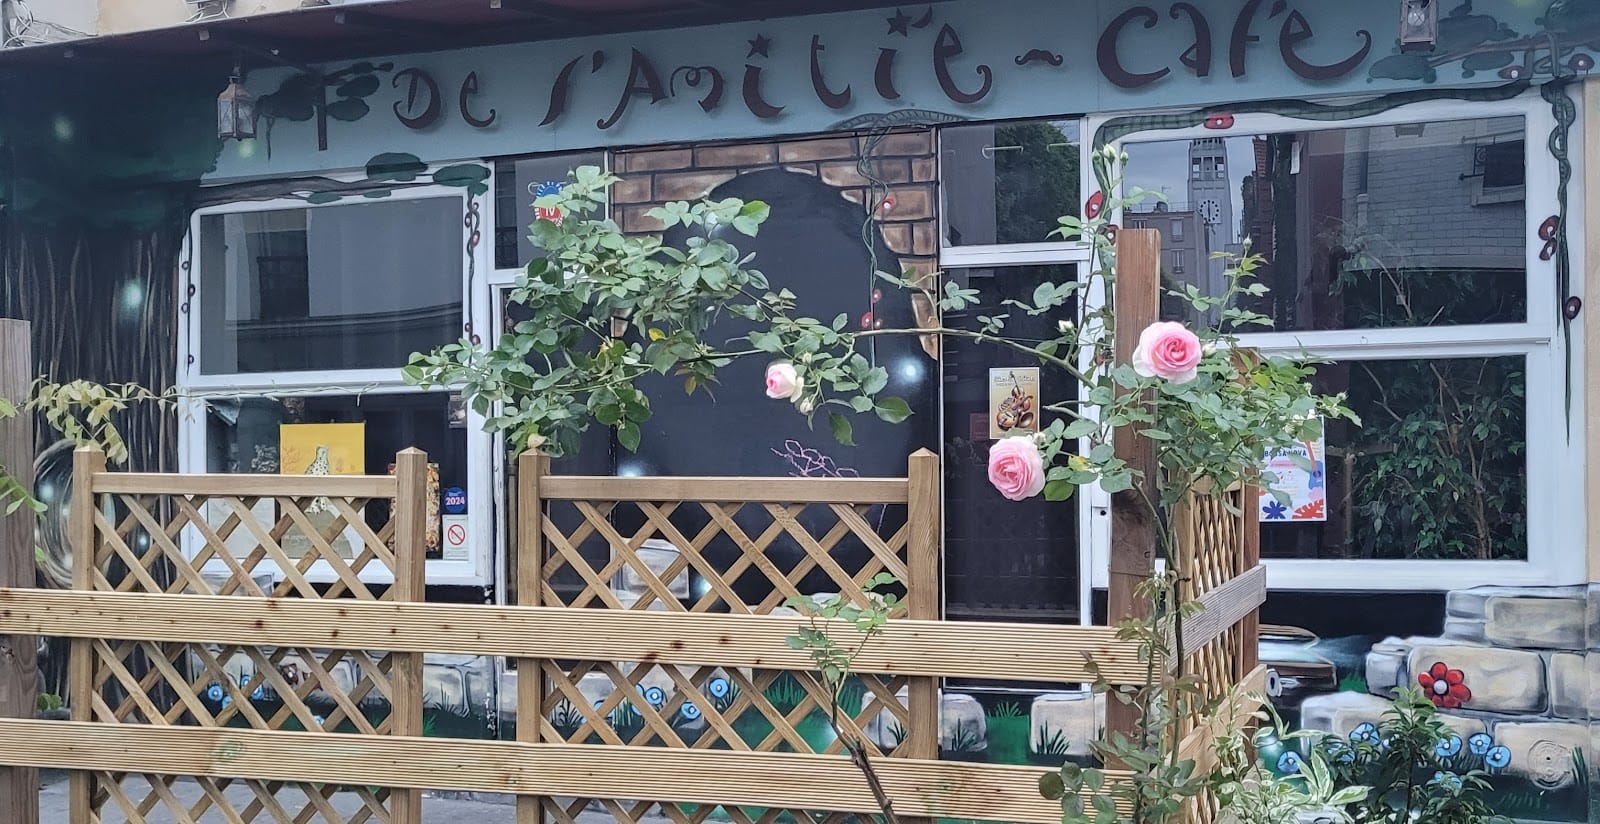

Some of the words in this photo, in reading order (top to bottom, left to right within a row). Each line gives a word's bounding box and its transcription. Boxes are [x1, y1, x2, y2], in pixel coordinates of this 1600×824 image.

[392, 67, 497, 129] De
[1096, 0, 1372, 88] Café
[445, 496, 465, 505] 2024
